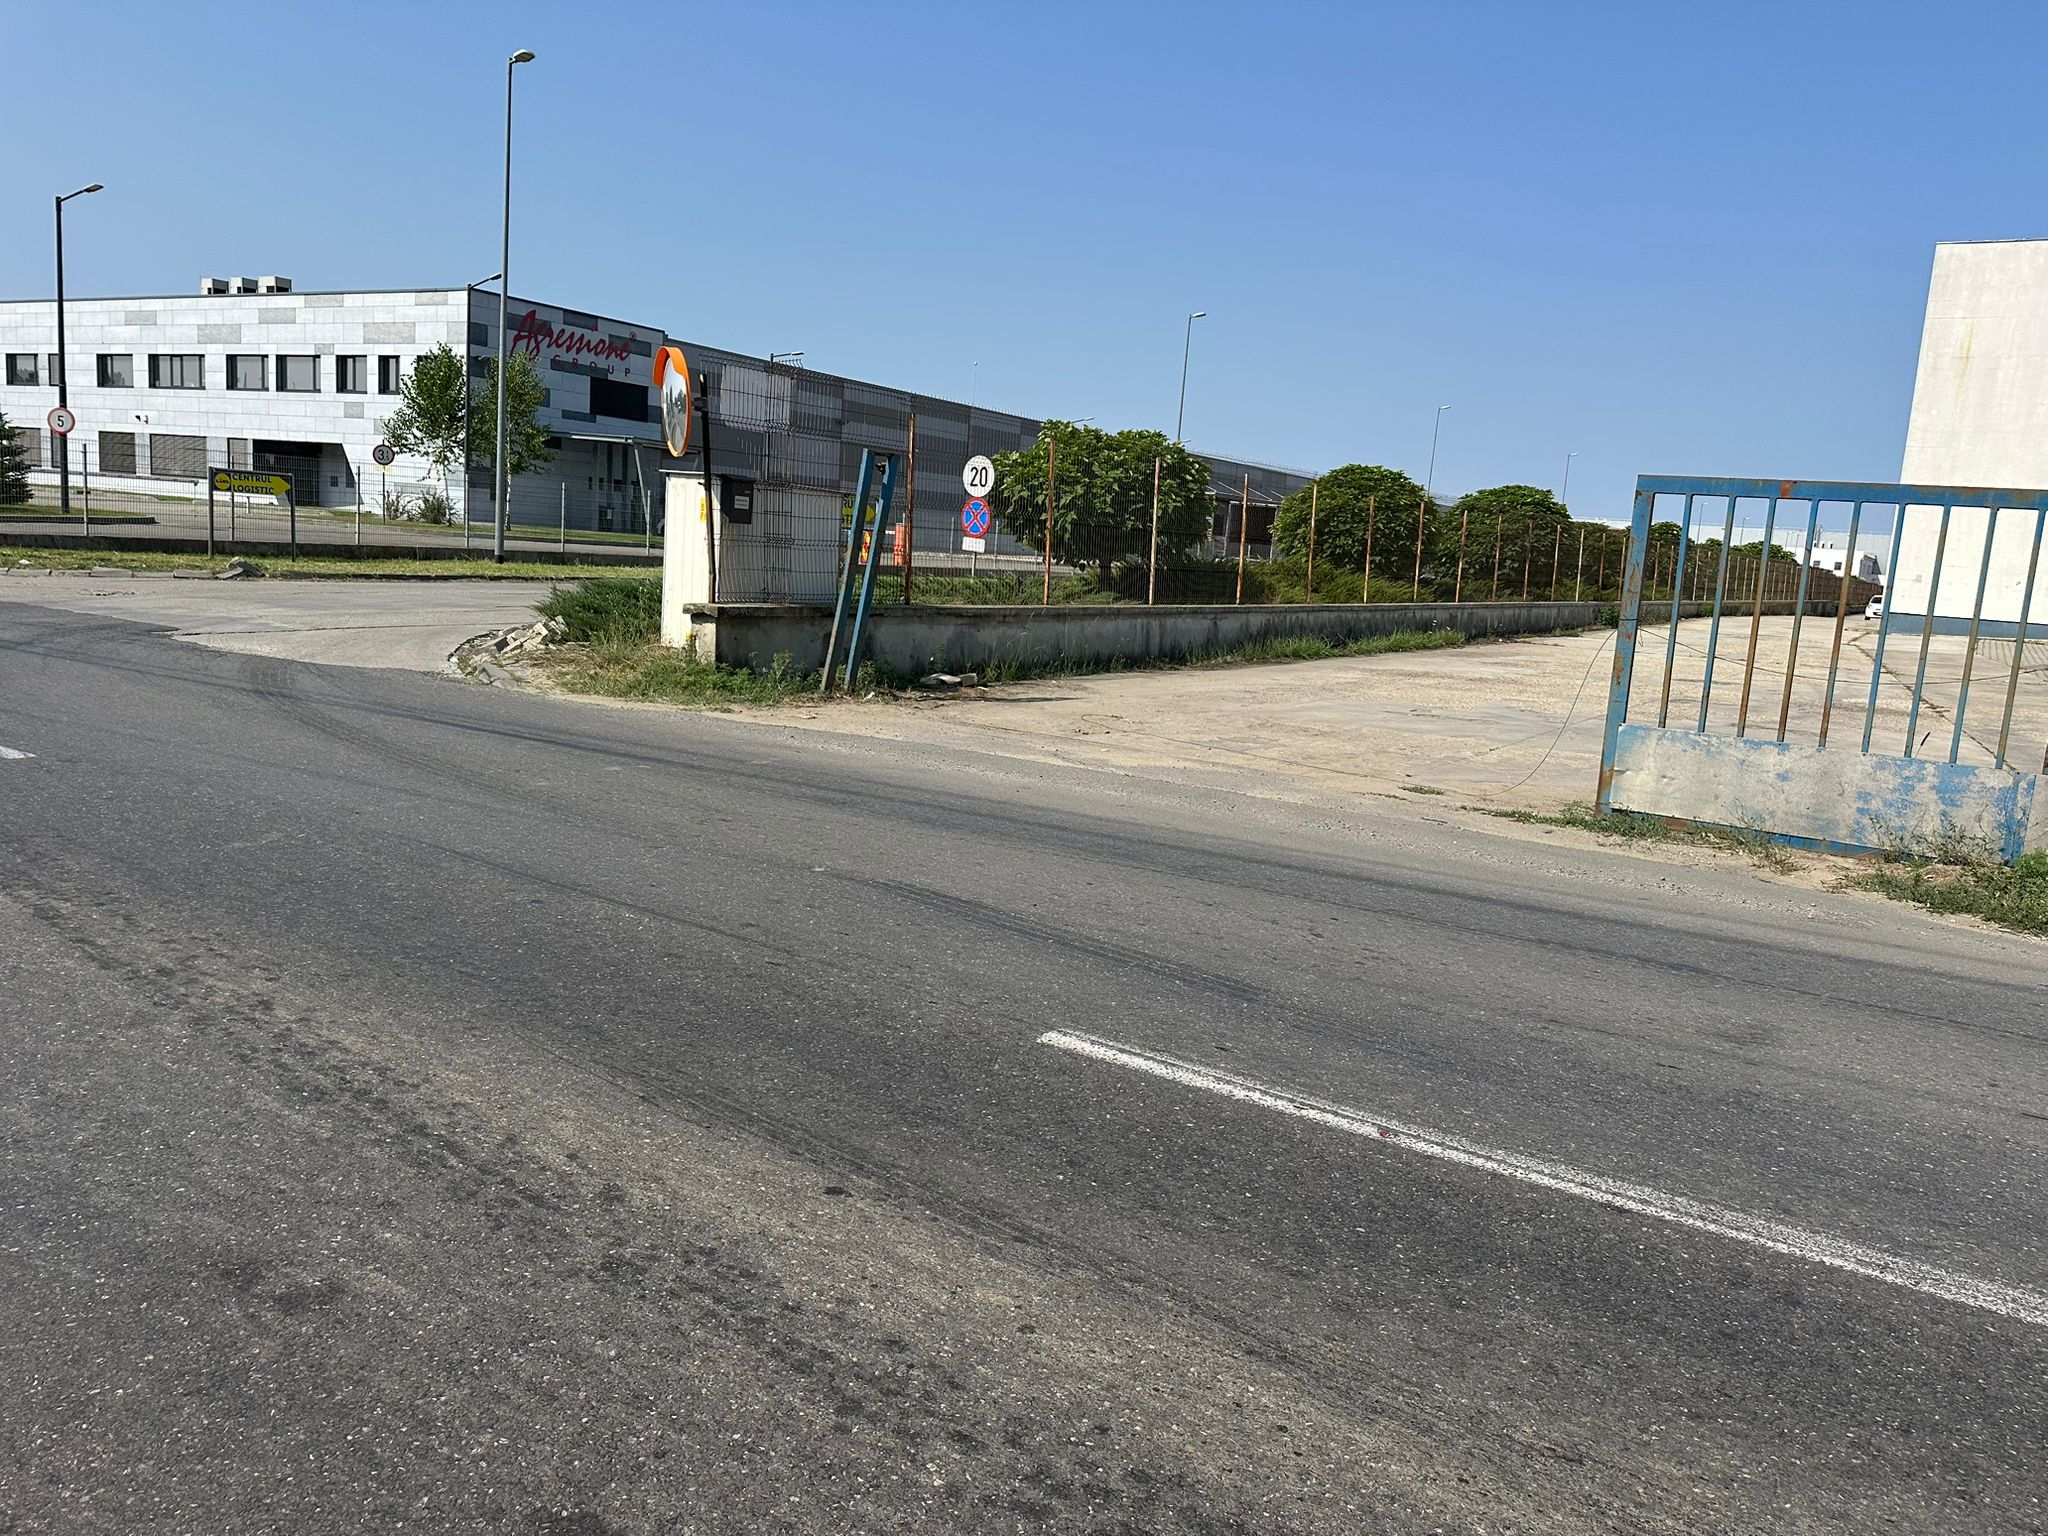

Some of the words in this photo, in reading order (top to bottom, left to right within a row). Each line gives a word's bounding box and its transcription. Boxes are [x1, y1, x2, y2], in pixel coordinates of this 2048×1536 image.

[552, 354, 631, 377] GROUP
[57, 414, 65, 428] 5
[232, 472, 272, 484] CENTRUL
[970, 466, 988, 488] 20
[232, 484, 274, 495] LOGISTIC
